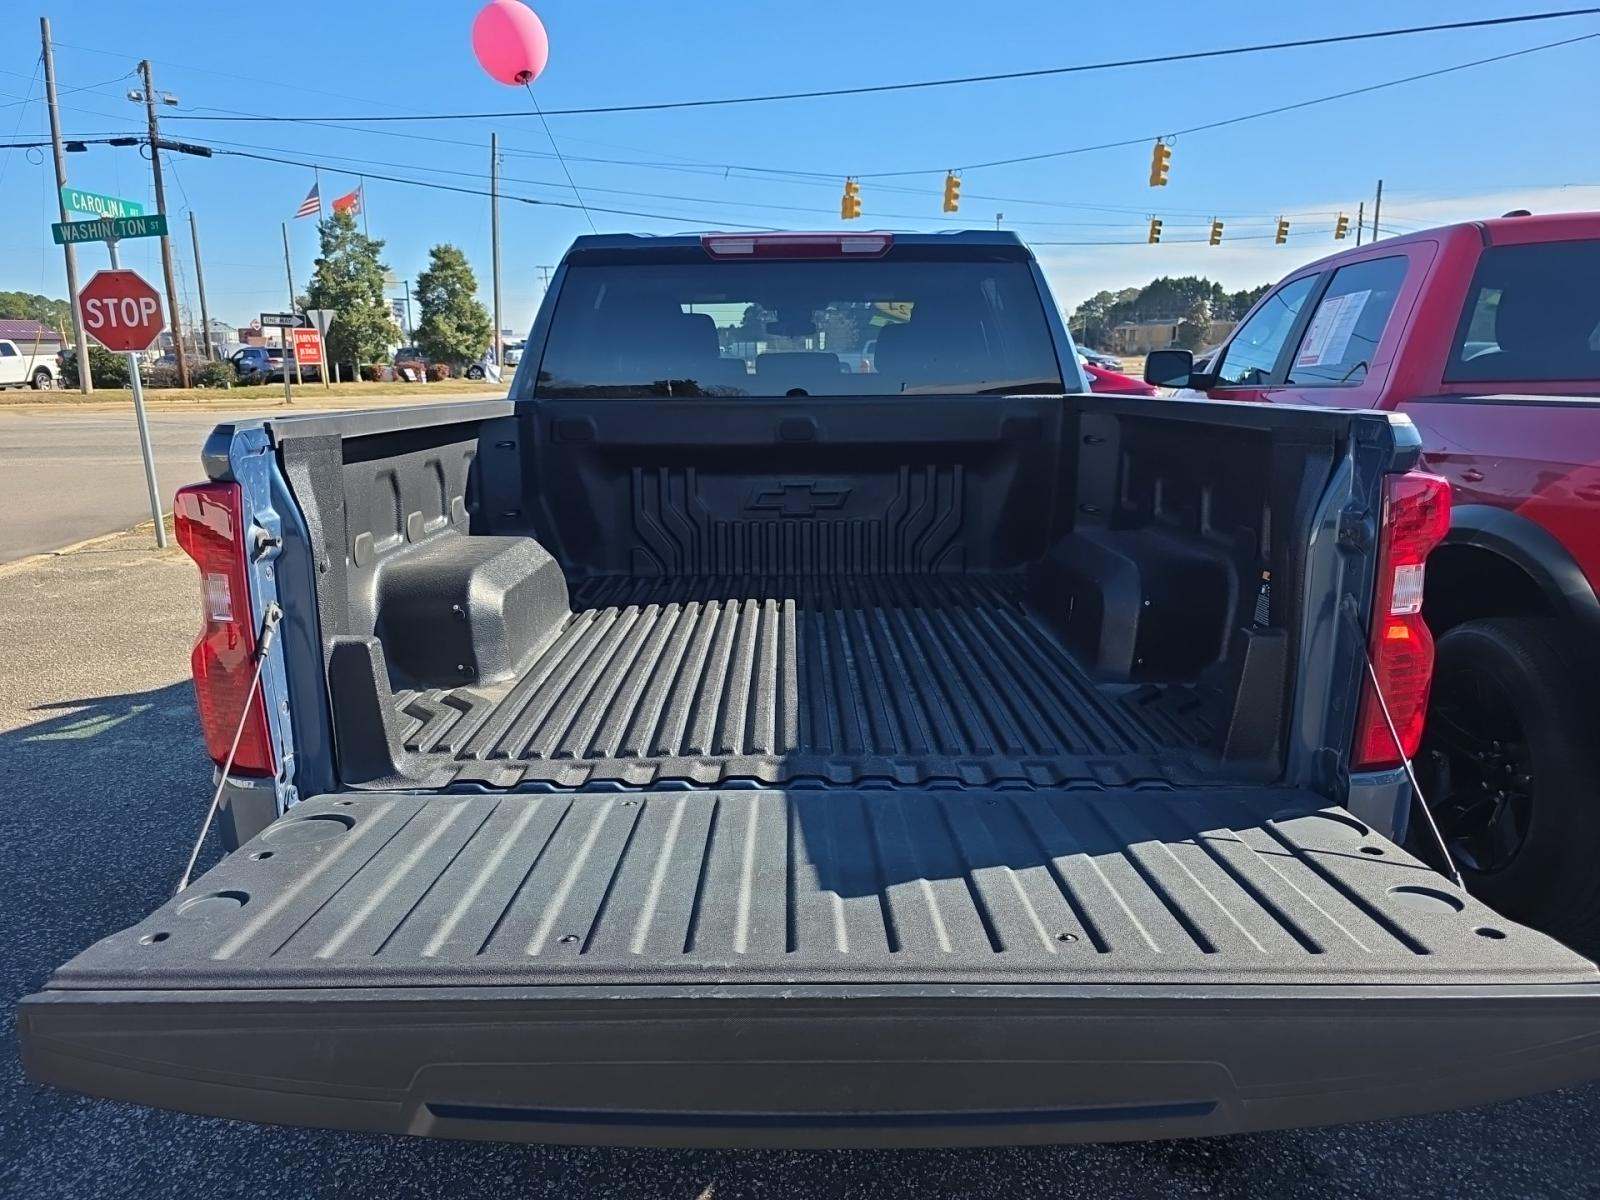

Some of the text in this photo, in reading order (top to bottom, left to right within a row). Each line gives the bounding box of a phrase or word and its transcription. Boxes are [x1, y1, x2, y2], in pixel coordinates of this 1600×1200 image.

[72, 192, 126, 218] CAROLINA
[60, 219, 160, 241] WASHINGTON ST
[86, 297, 157, 328] STOP
[264, 316, 292, 325] ONE WAY
